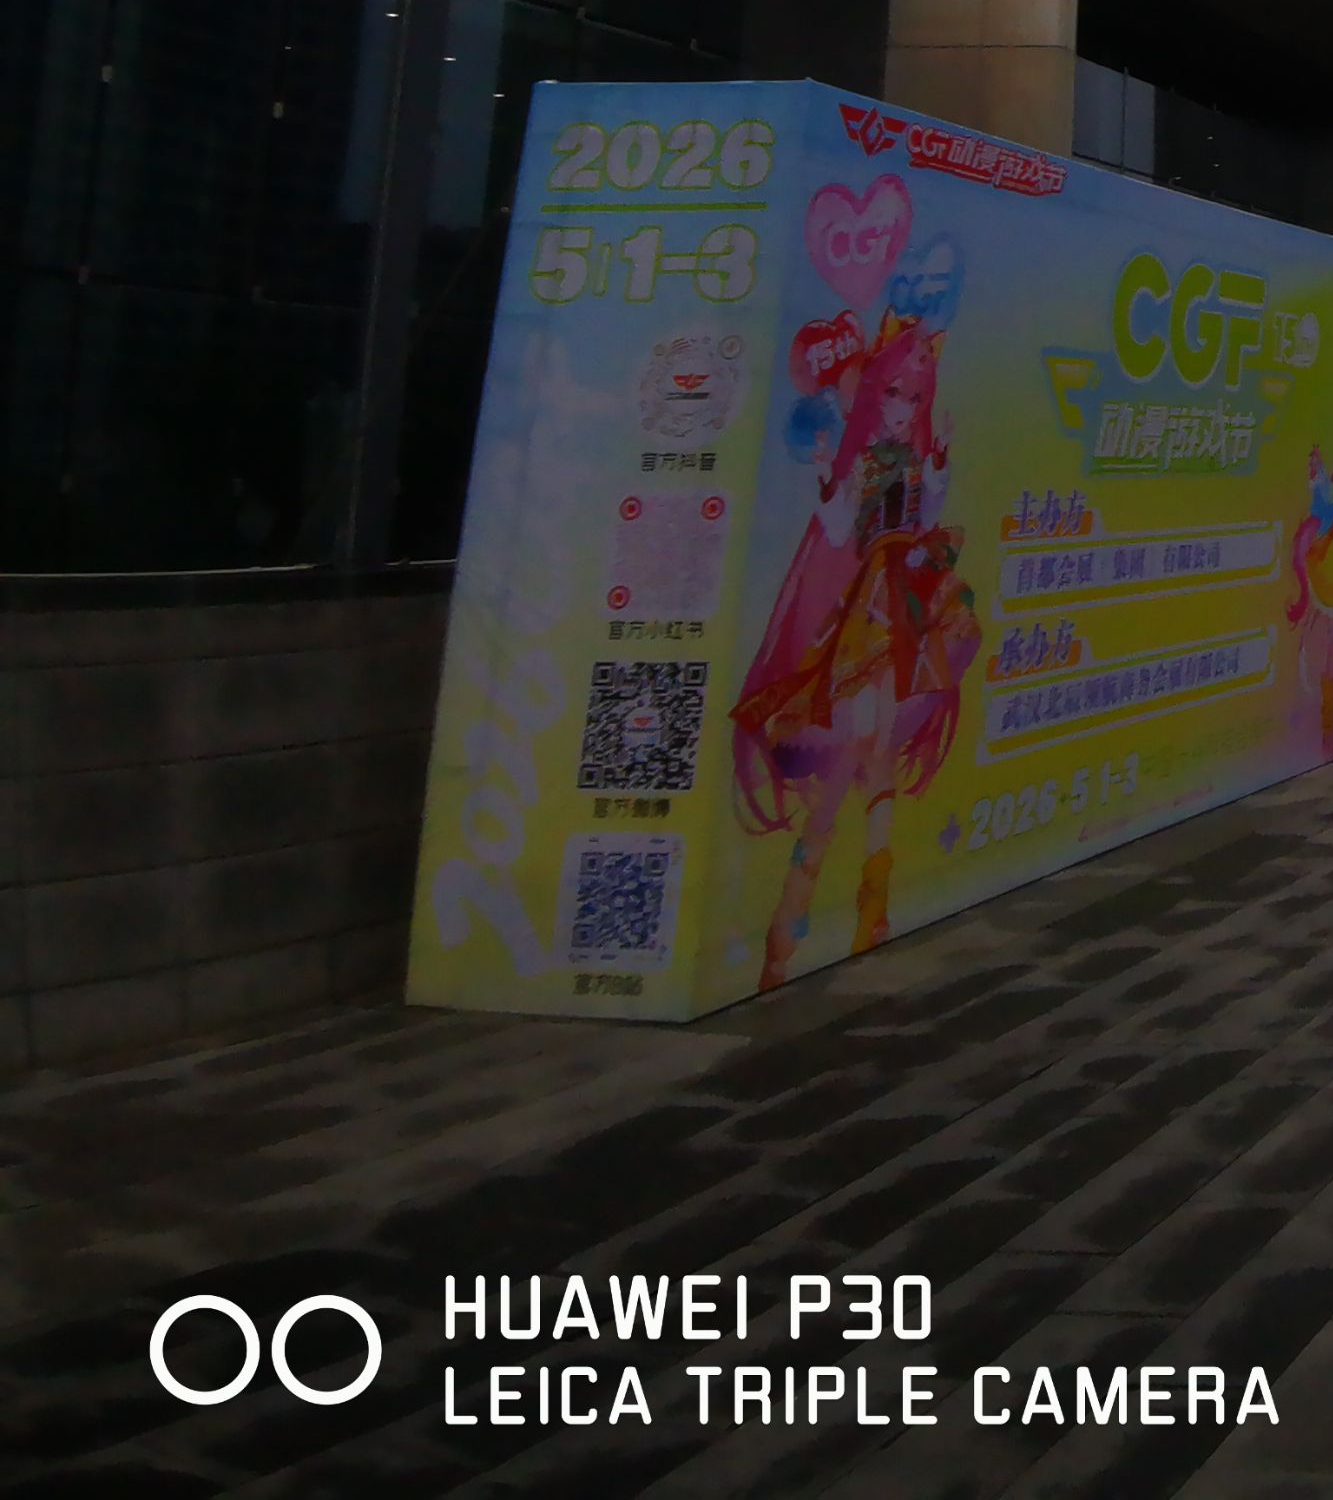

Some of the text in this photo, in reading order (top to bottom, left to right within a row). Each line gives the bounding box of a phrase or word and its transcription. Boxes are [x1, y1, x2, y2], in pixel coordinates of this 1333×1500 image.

[547, 118, 776, 191] 2026
[608, 620, 704, 641] 官方小红书
